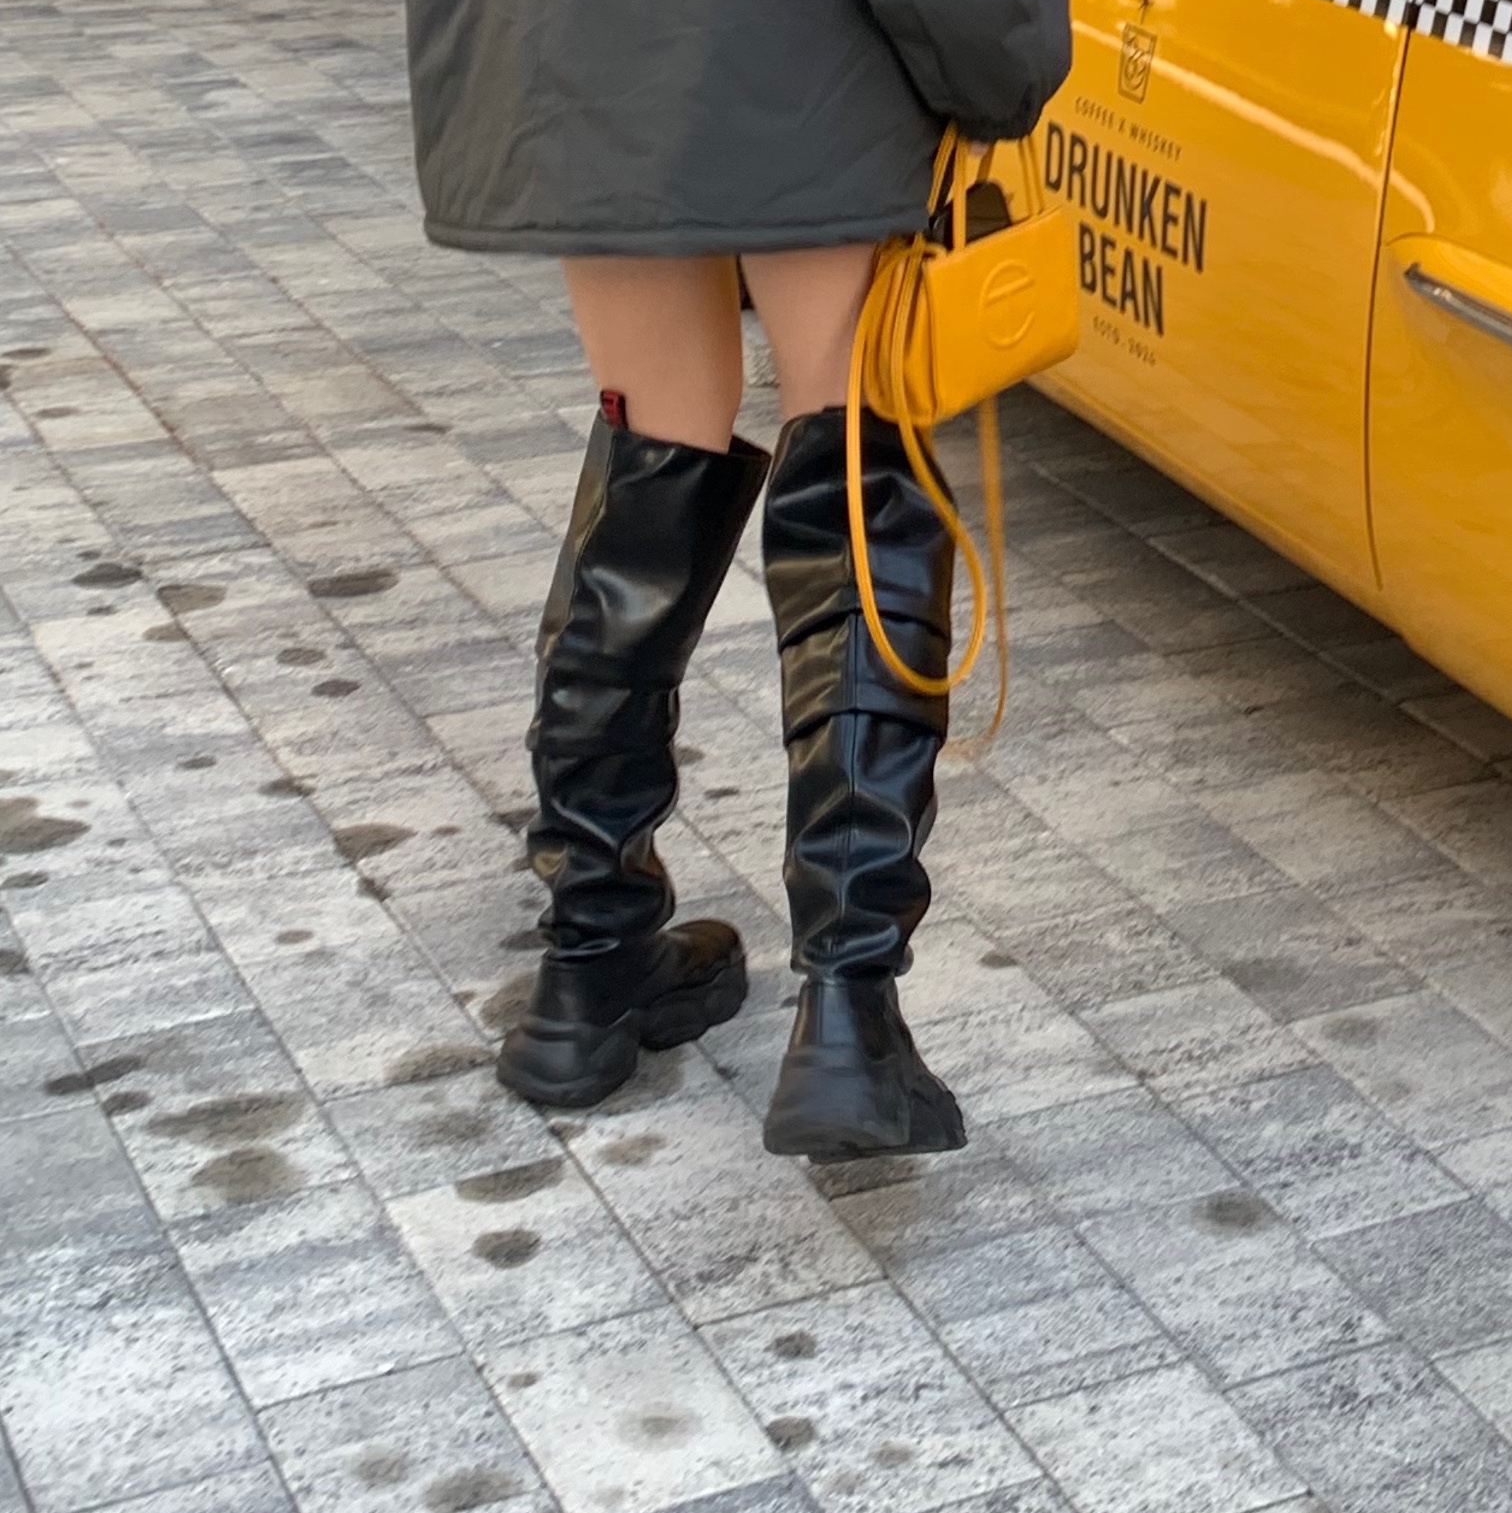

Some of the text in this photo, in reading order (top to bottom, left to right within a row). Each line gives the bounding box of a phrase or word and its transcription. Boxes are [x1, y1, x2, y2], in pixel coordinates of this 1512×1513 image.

[1074, 95, 1115, 131] COFFEE
[1128, 121, 1183, 163] WHISKEY
[1045, 120, 1207, 274] DRUNKEN
[1078, 220, 1165, 338] BEAN
